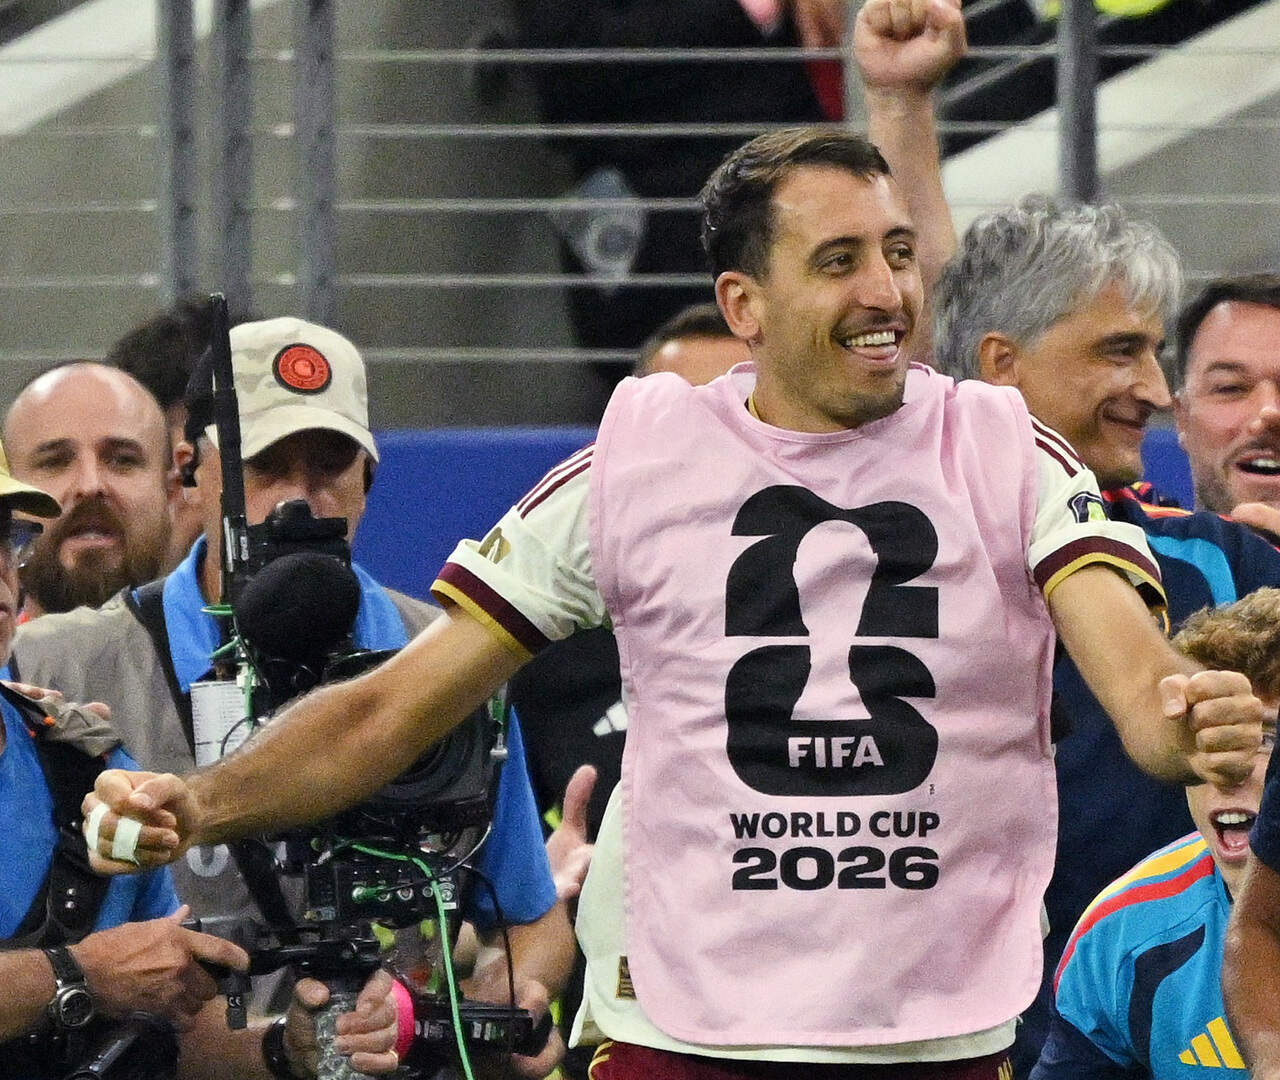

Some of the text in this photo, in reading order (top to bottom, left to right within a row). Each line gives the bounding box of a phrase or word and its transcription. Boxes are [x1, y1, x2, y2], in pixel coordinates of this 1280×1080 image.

[788, 735, 884, 768] FIFA
[730, 811, 939, 839] WORLD CUP
[732, 846, 939, 891] 2026
